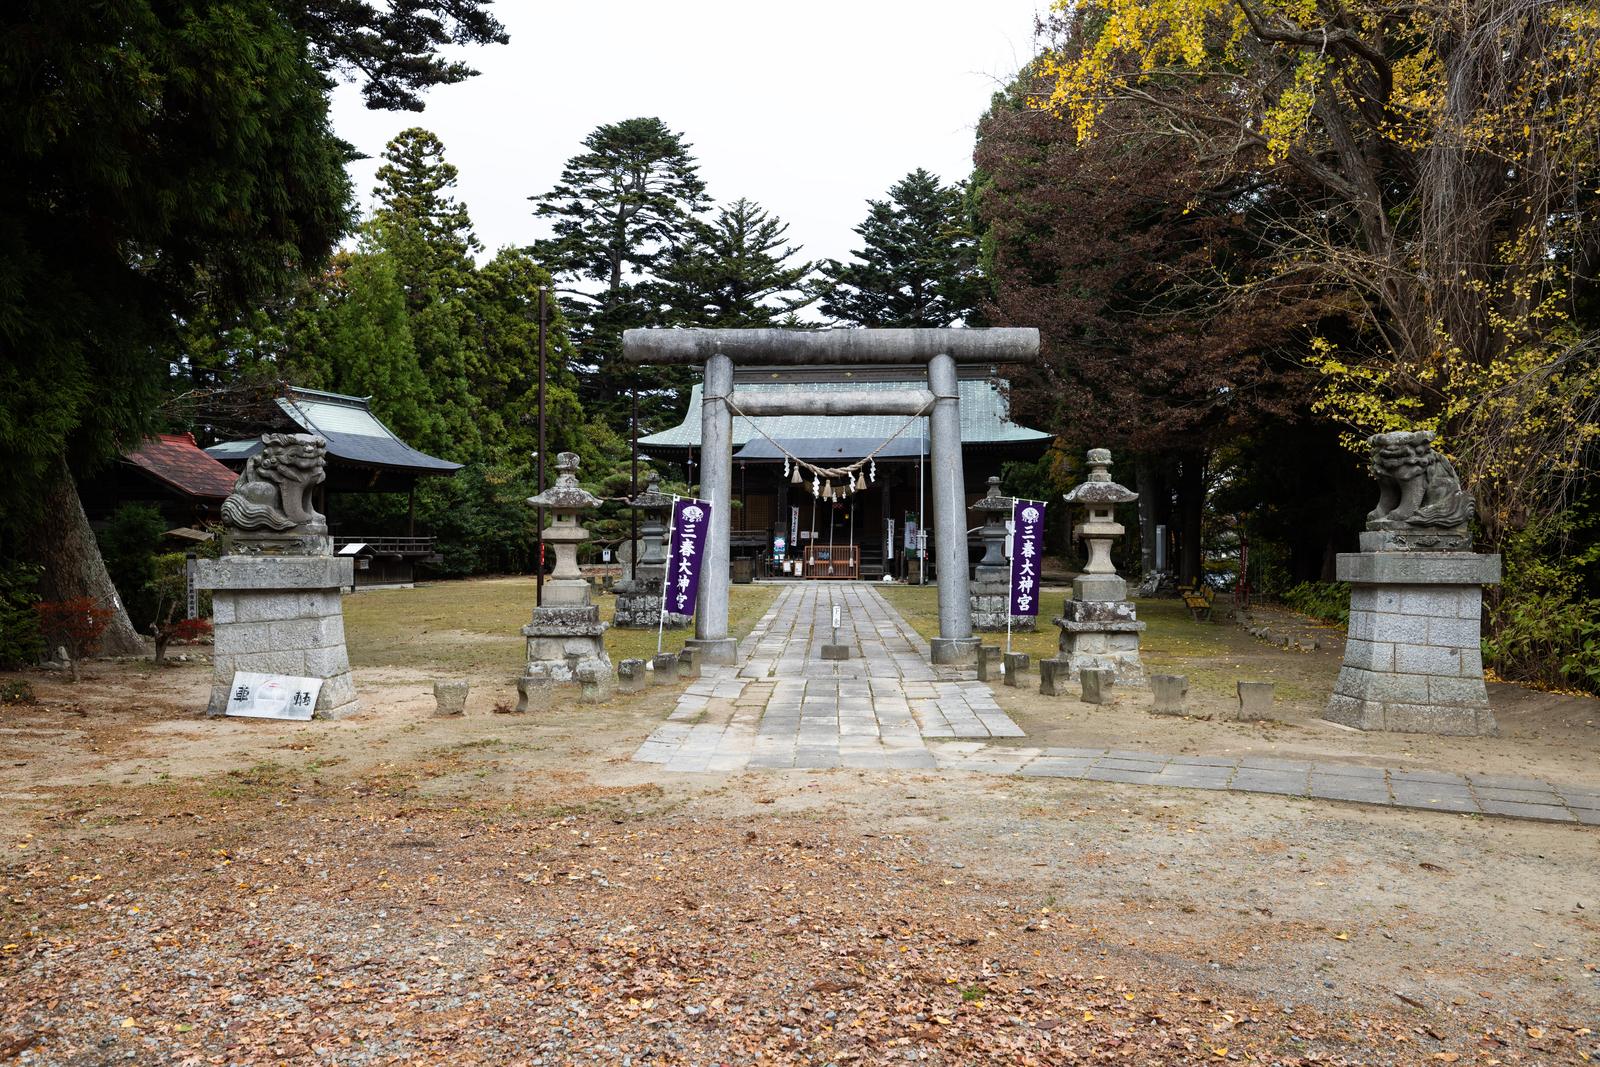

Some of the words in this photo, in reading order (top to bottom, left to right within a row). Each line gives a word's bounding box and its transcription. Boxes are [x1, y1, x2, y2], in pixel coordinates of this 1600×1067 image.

[676, 524, 697, 610] 三春大神宮
[1017, 525, 1036, 611] 三春大神宮
